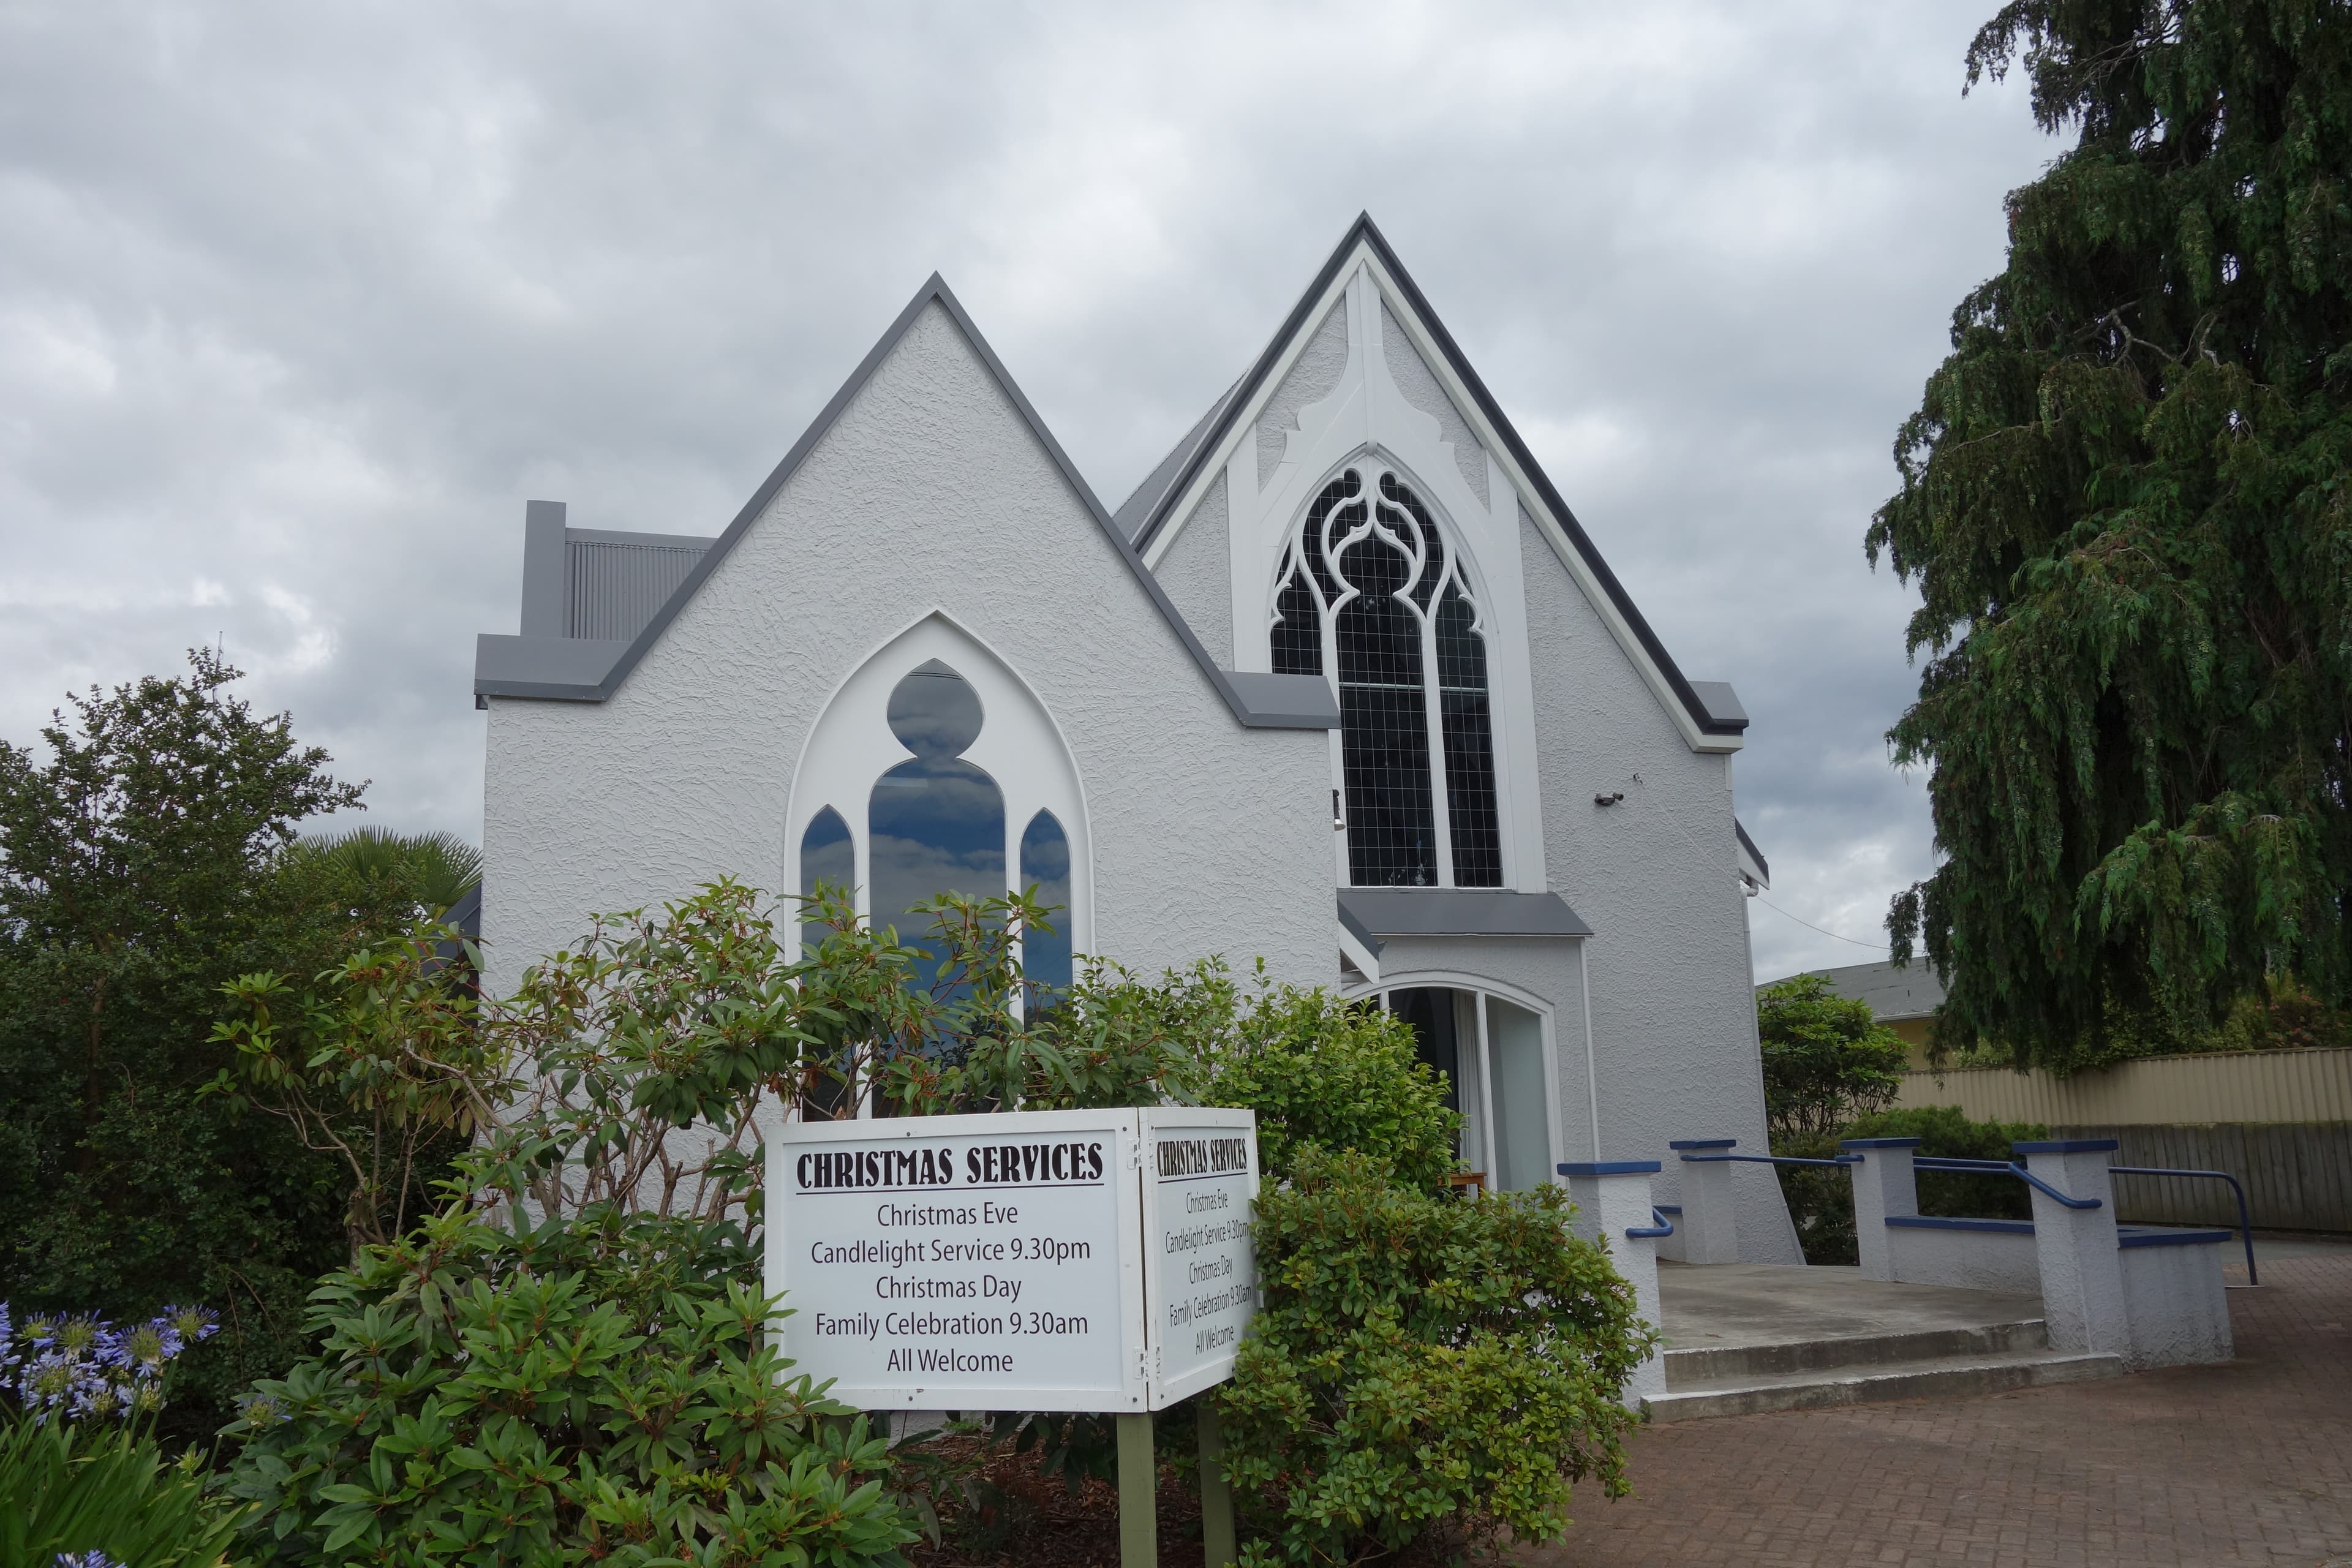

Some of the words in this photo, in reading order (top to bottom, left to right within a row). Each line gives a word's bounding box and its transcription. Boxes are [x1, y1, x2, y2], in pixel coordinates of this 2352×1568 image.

[797, 1148, 952, 1189] CHRISTMAS
[967, 1142, 1103, 1184] SERVICES
[1157, 1140, 1207, 1177] CHRISTMAS
[1210, 1138, 1246, 1172] SERVICES
[877, 1204, 977, 1226] Christmas
[984, 1202, 1019, 1224] Eve
[1186, 1191, 1216, 1213] Christmas
[1218, 1189, 1227, 1208] Eve
[1166, 1226, 1204, 1254] Candlelight
[1205, 1223, 1226, 1245] Service
[1227, 1219, 1248, 1243] 9.30pm
[811, 1240, 925, 1268] Candlelight
[931, 1238, 1004, 1262] Service
[1011, 1237, 1090, 1265] 9.30pm
[1189, 1261, 1220, 1284] Christmas
[1221, 1255, 1232, 1279] Day
[876, 1275, 976, 1298] Christmas
[984, 1275, 1022, 1303] Day
[1170, 1299, 1192, 1328] Family
[1194, 1290, 1229, 1318] Celebration
[1231, 1284, 1251, 1306] 9.30am
[816, 1313, 879, 1341] Family
[886, 1312, 1003, 1335] Celebration
[1009, 1312, 1088, 1334] 9.30am
[1205, 1325, 1234, 1351] Welcome
[887, 1349, 912, 1372] All
[918, 1349, 1014, 1372] Welcome
